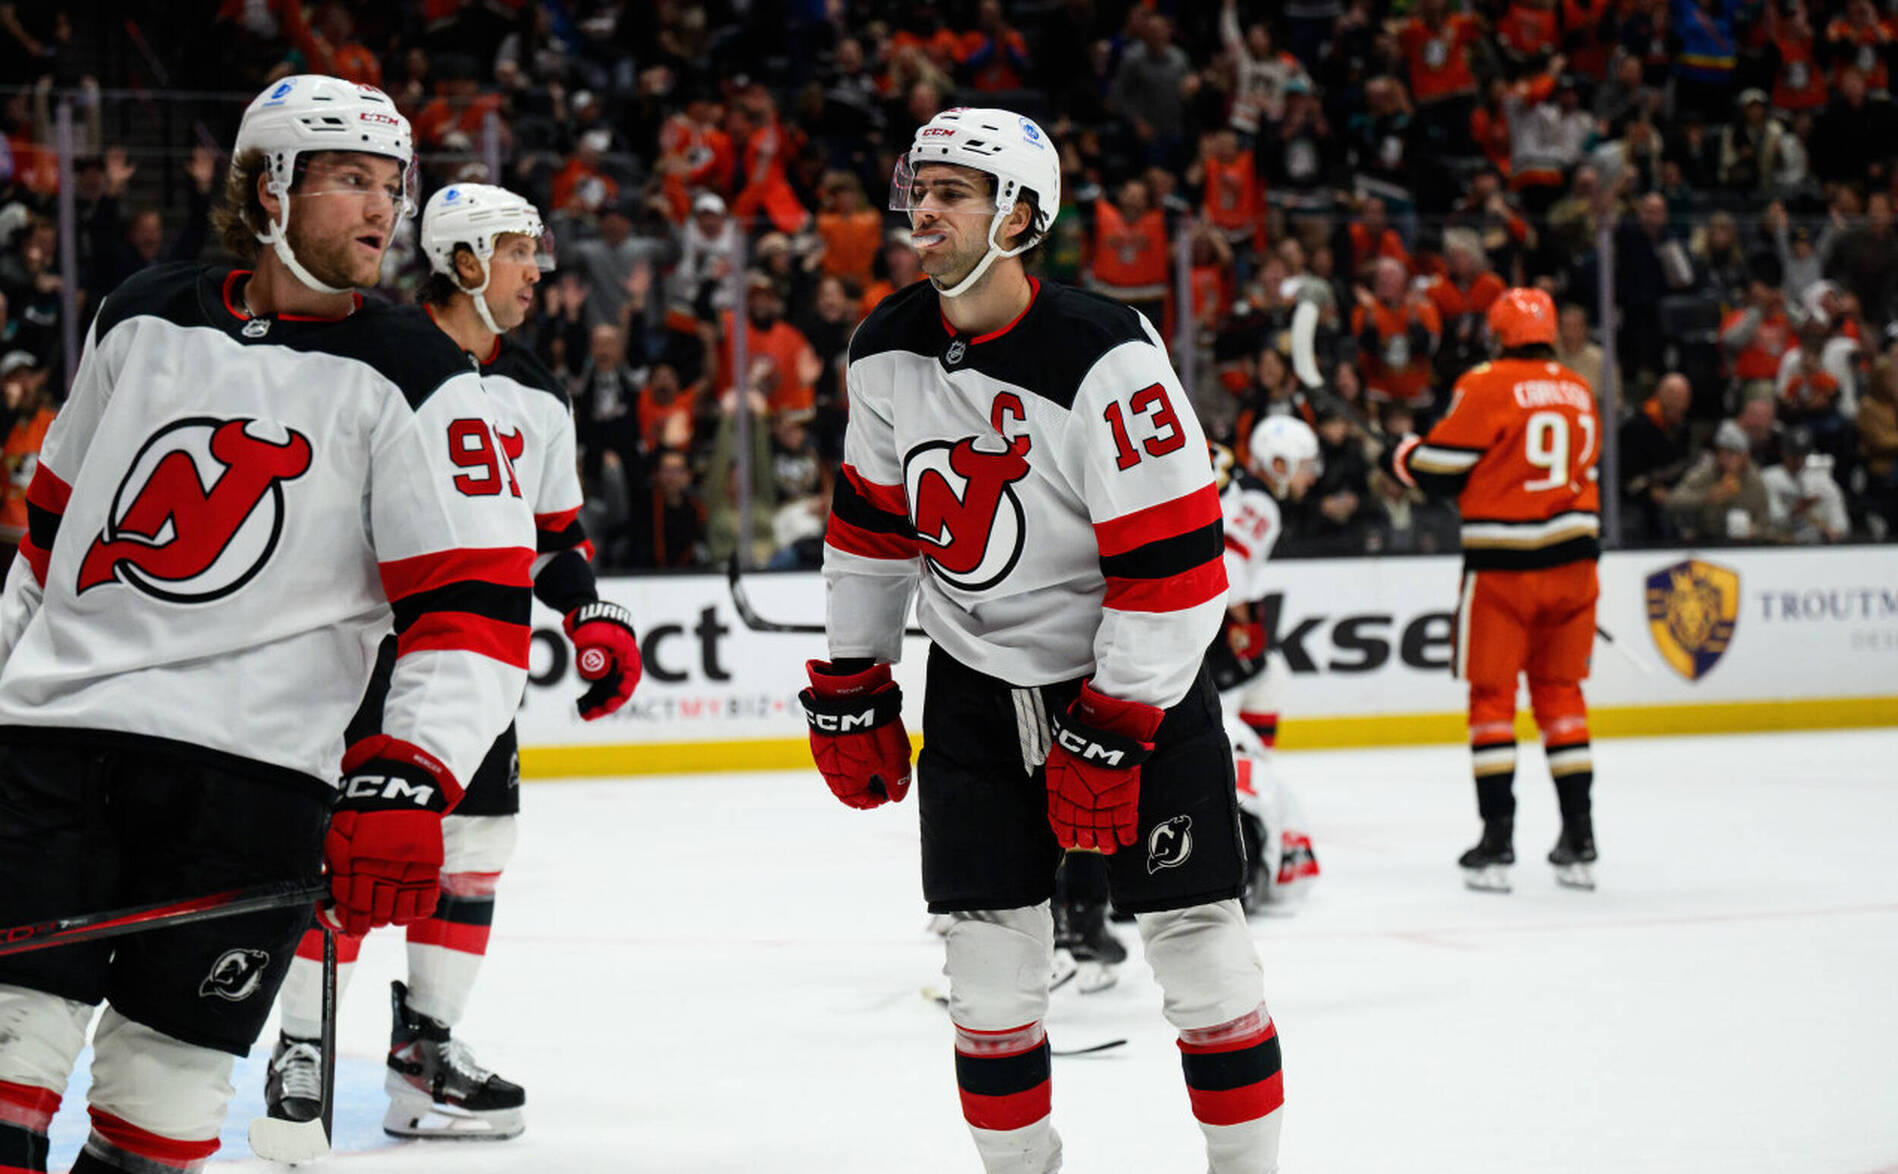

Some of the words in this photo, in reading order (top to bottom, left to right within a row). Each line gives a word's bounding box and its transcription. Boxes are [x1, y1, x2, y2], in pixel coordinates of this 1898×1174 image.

[360, 112, 399, 126] CCM
[922, 128, 956, 137] CCM
[991, 391, 1032, 457] C
[1104, 382, 1186, 471] 13
